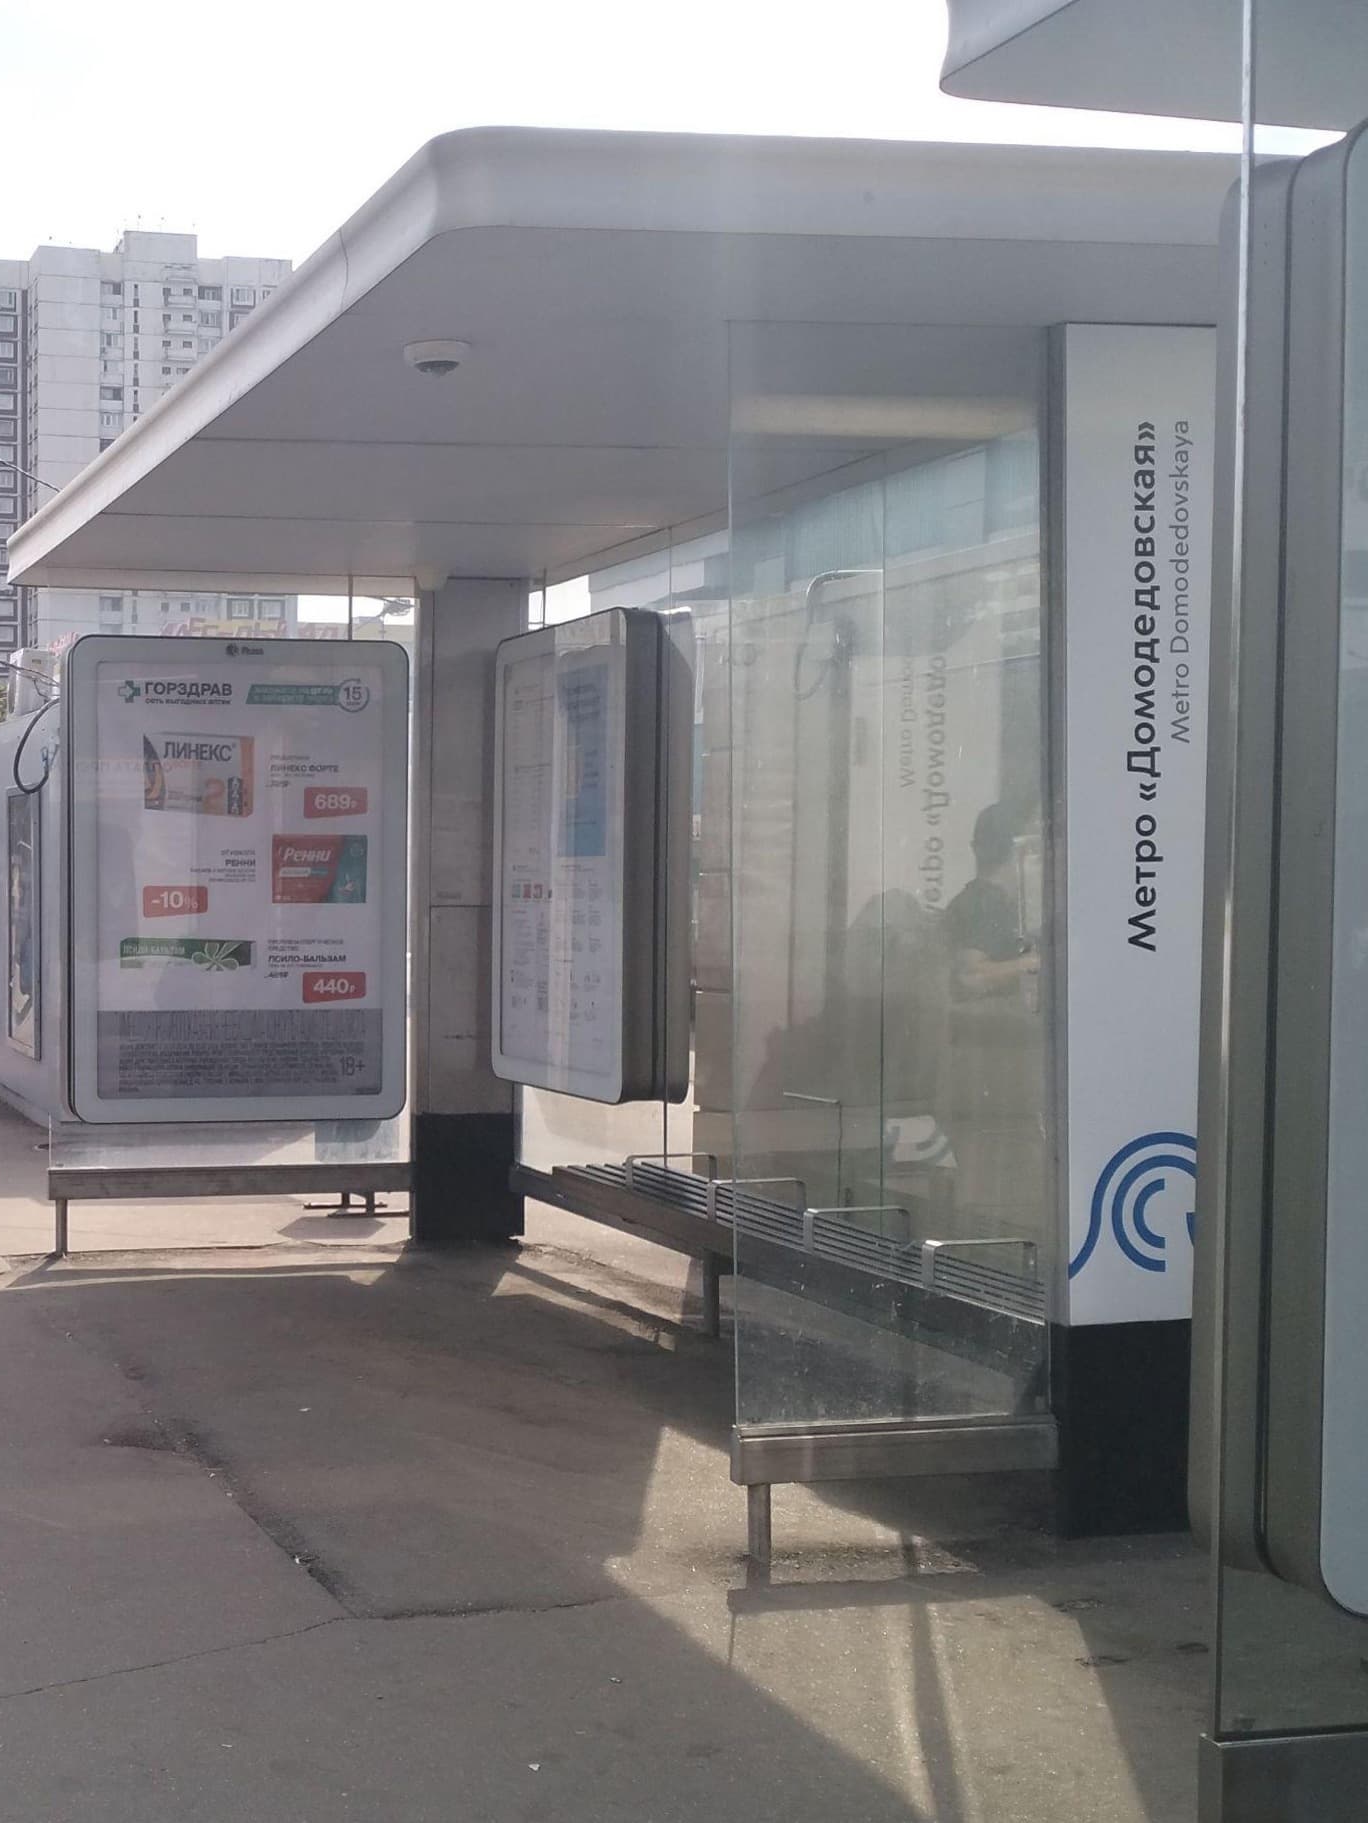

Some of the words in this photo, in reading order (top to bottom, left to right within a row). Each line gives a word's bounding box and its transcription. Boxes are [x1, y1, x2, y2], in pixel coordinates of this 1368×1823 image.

[1168, 420, 1193, 654] Domodedovskaya
[1126, 420, 1161, 801] «Домодедовская»
[144, 682, 233, 698] ГОРЗДРАВ
[343, 686, 362, 701] 15
[1170, 663, 1191, 744] Metro
[163, 741, 233, 762] ЛИНЕКС
[1127, 814, 1163, 952] Метро
